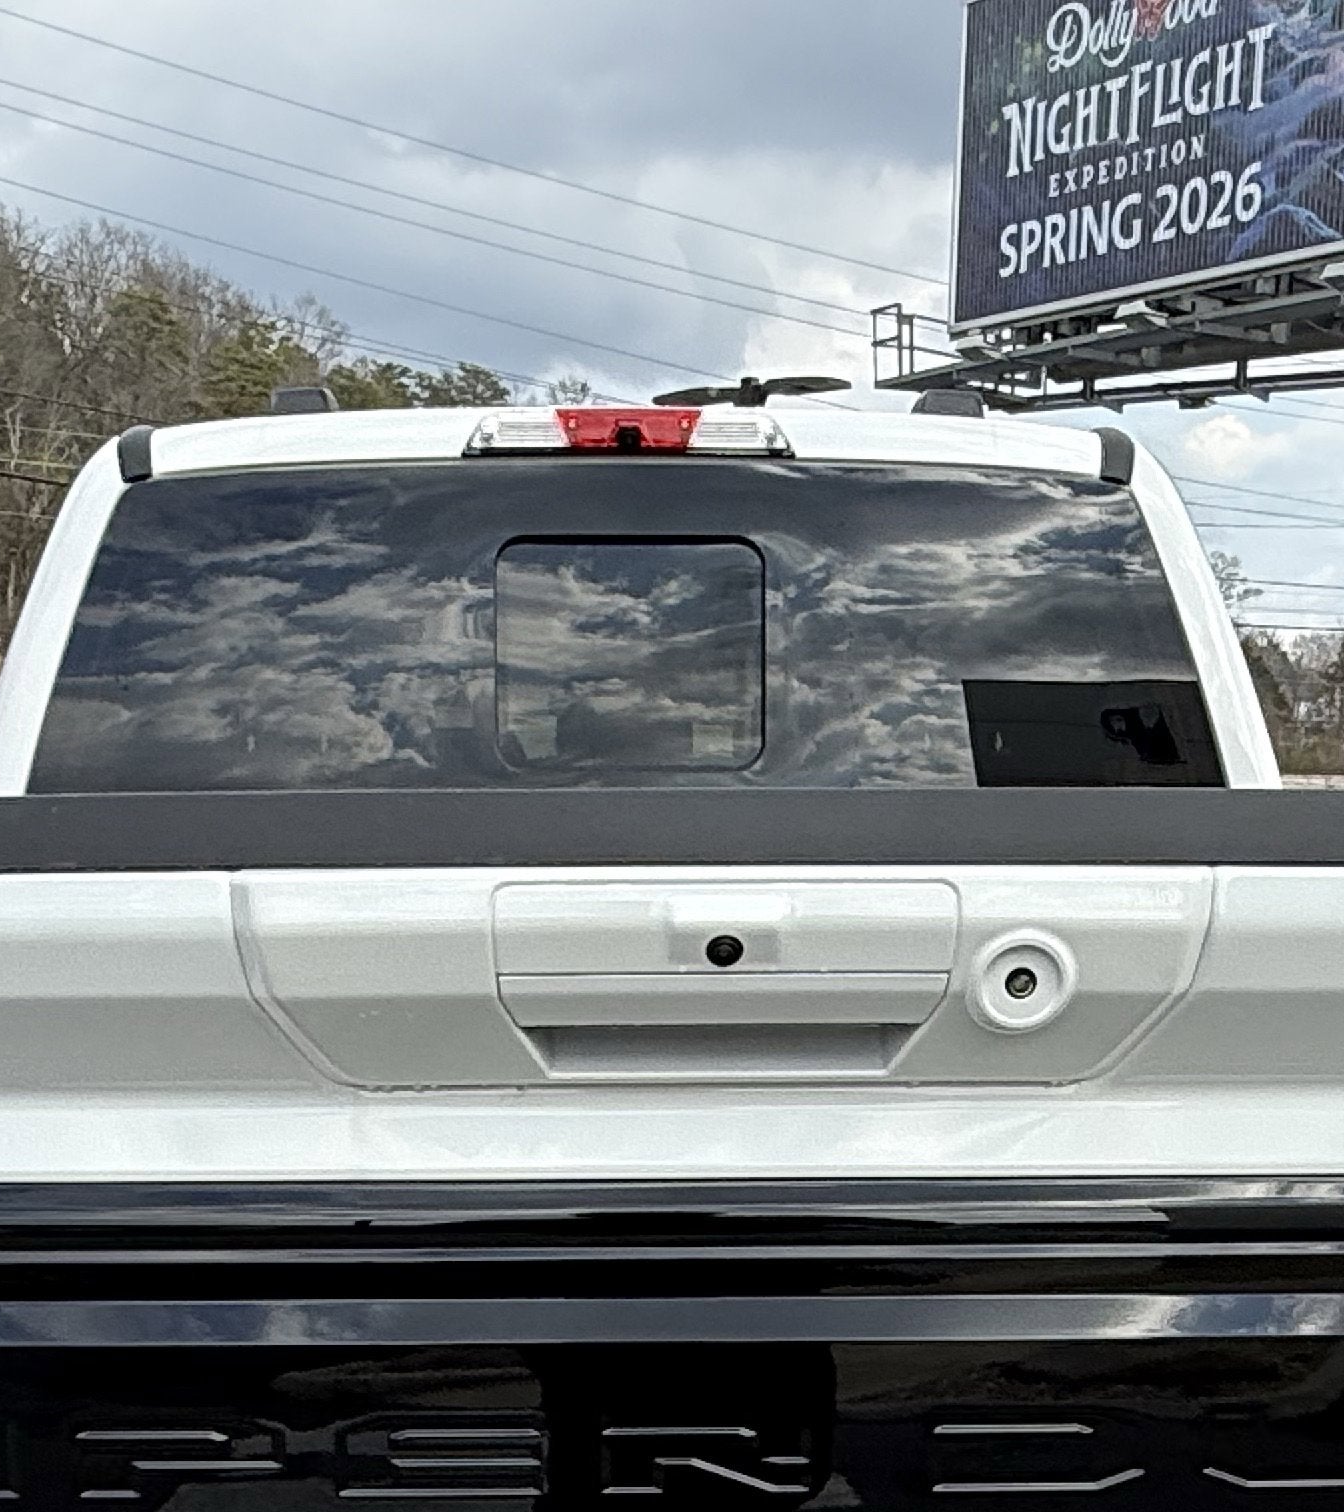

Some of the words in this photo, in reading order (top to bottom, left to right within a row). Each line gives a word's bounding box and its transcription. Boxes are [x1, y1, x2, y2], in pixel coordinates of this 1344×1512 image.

[1002, 23, 1278, 178] NIGHTFLIGHT
[999, 192, 1142, 278] SPRING
[1152, 161, 1262, 243] 2026
[1048, 134, 1206, 198] EXPEDITION
